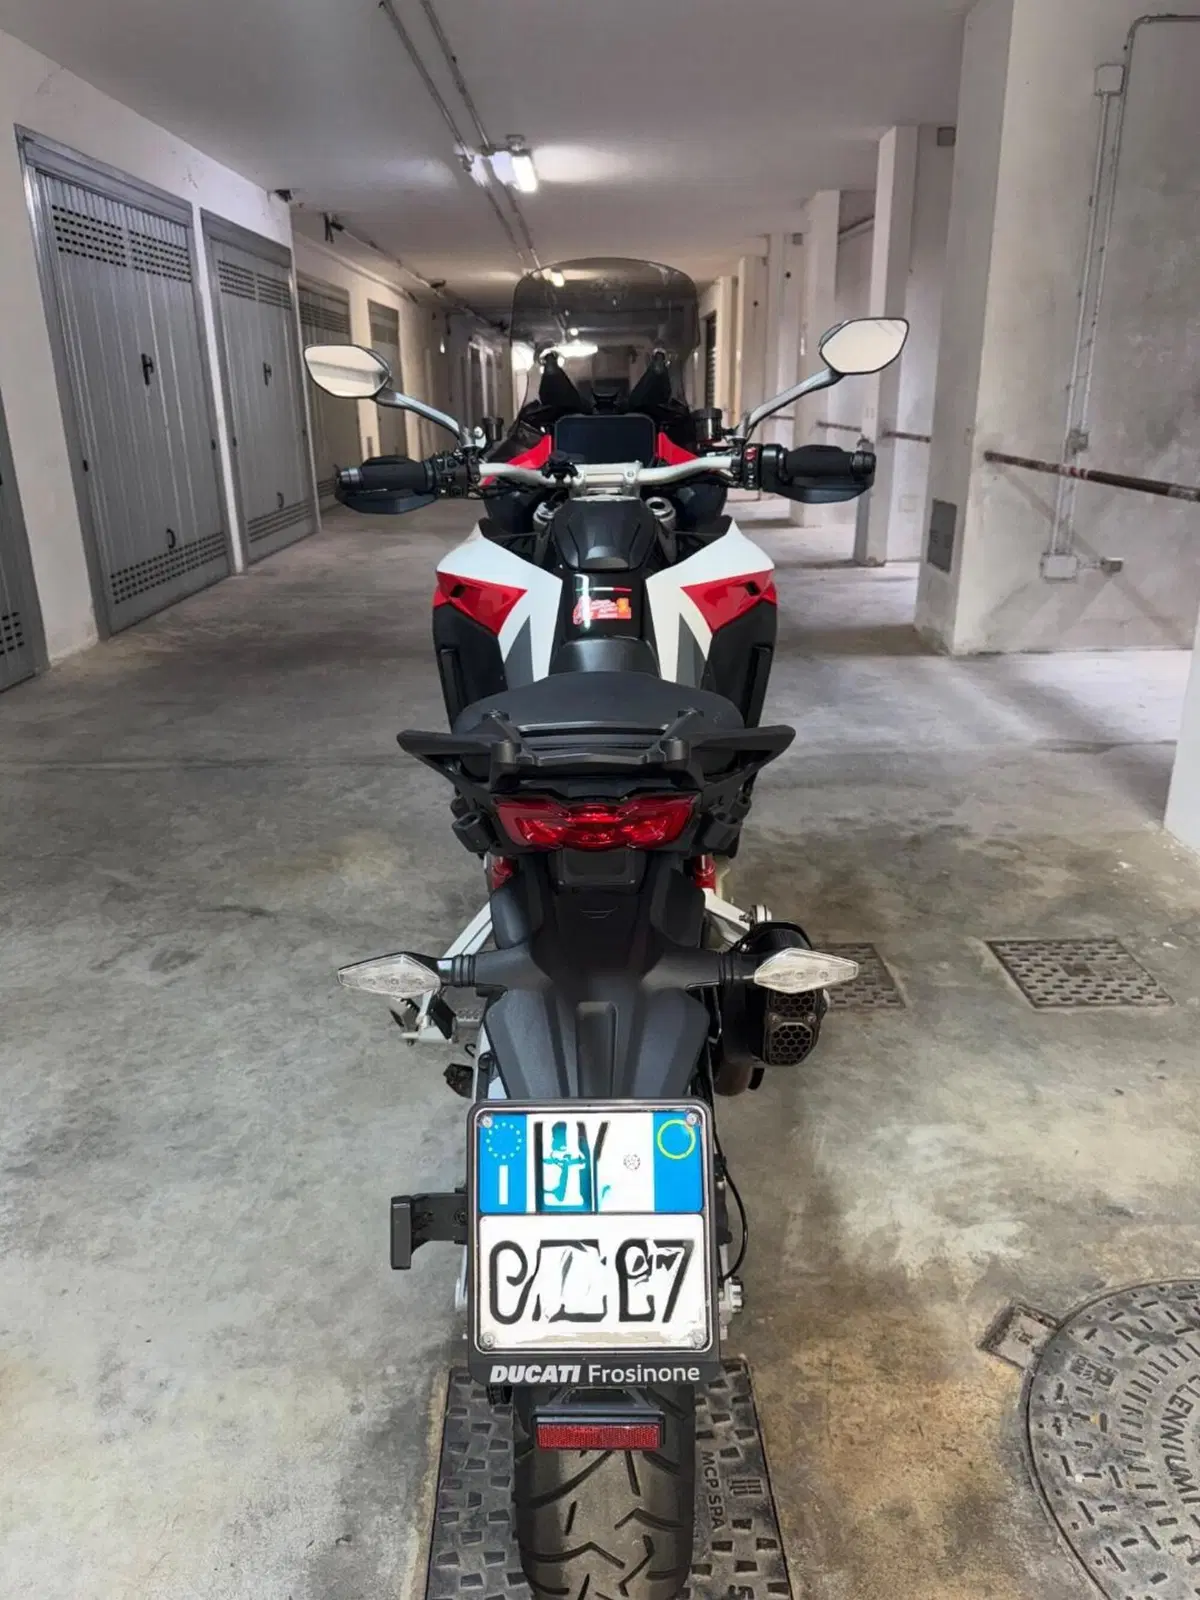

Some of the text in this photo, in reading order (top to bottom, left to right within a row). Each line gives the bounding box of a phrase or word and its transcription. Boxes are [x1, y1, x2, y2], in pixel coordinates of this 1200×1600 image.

[489, 1364, 701, 1384] DUCATI Frosinone
[701, 1451, 726, 1530] MCP SPA
